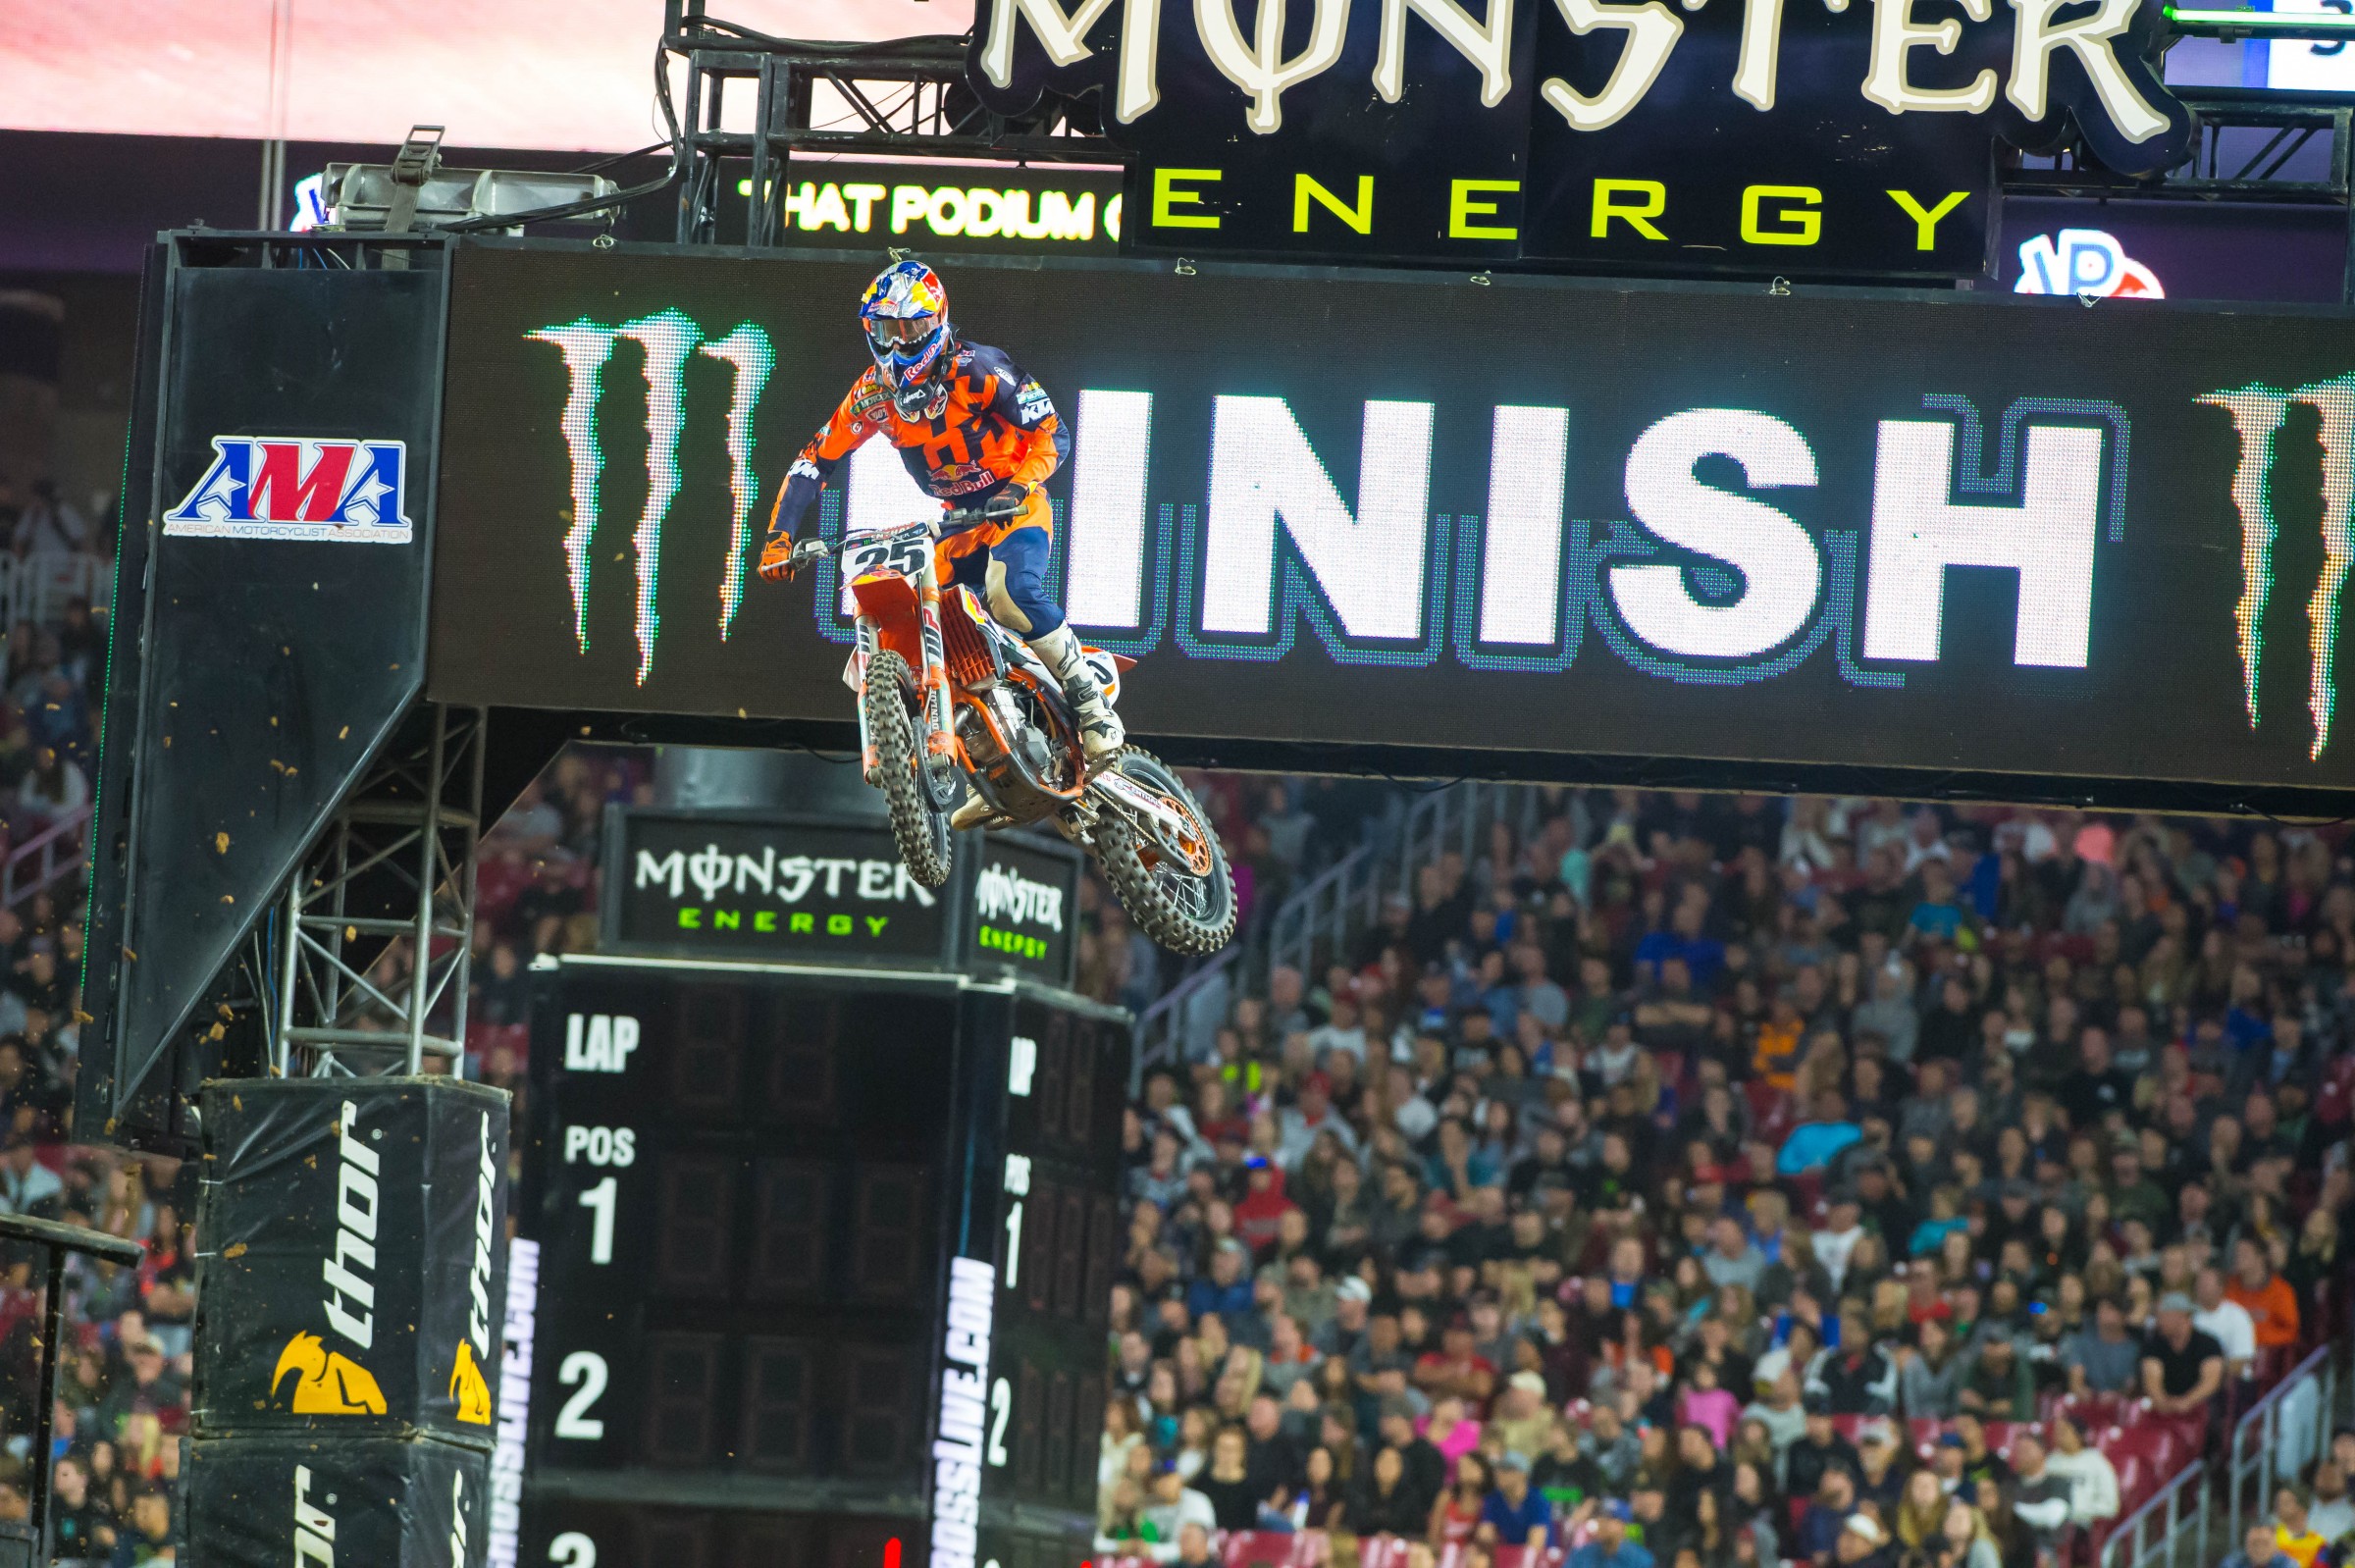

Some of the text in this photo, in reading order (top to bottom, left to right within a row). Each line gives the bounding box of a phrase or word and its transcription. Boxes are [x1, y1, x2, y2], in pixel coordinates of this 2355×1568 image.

[738, 179, 887, 233] HAT
[891, 184, 1096, 241] PODIUM
[1152, 168, 1970, 251] ENERGY
[168, 441, 409, 527] AMA
[167, 523, 409, 540] AMERICAN MOTORCYCLIST ASSOCIATION
[855, 539, 925, 577] 25
[677, 907, 890, 938] ENERGY
[564, 1013, 641, 1072] LAP
[564, 1125, 637, 1168] POS
[323, 1099, 381, 1350] thor
[578, 1176, 617, 1265] 1
[1005, 1200, 1023, 1289] 1
[553, 1350, 608, 1440] 2
[987, 1376, 1012, 1468] 2
